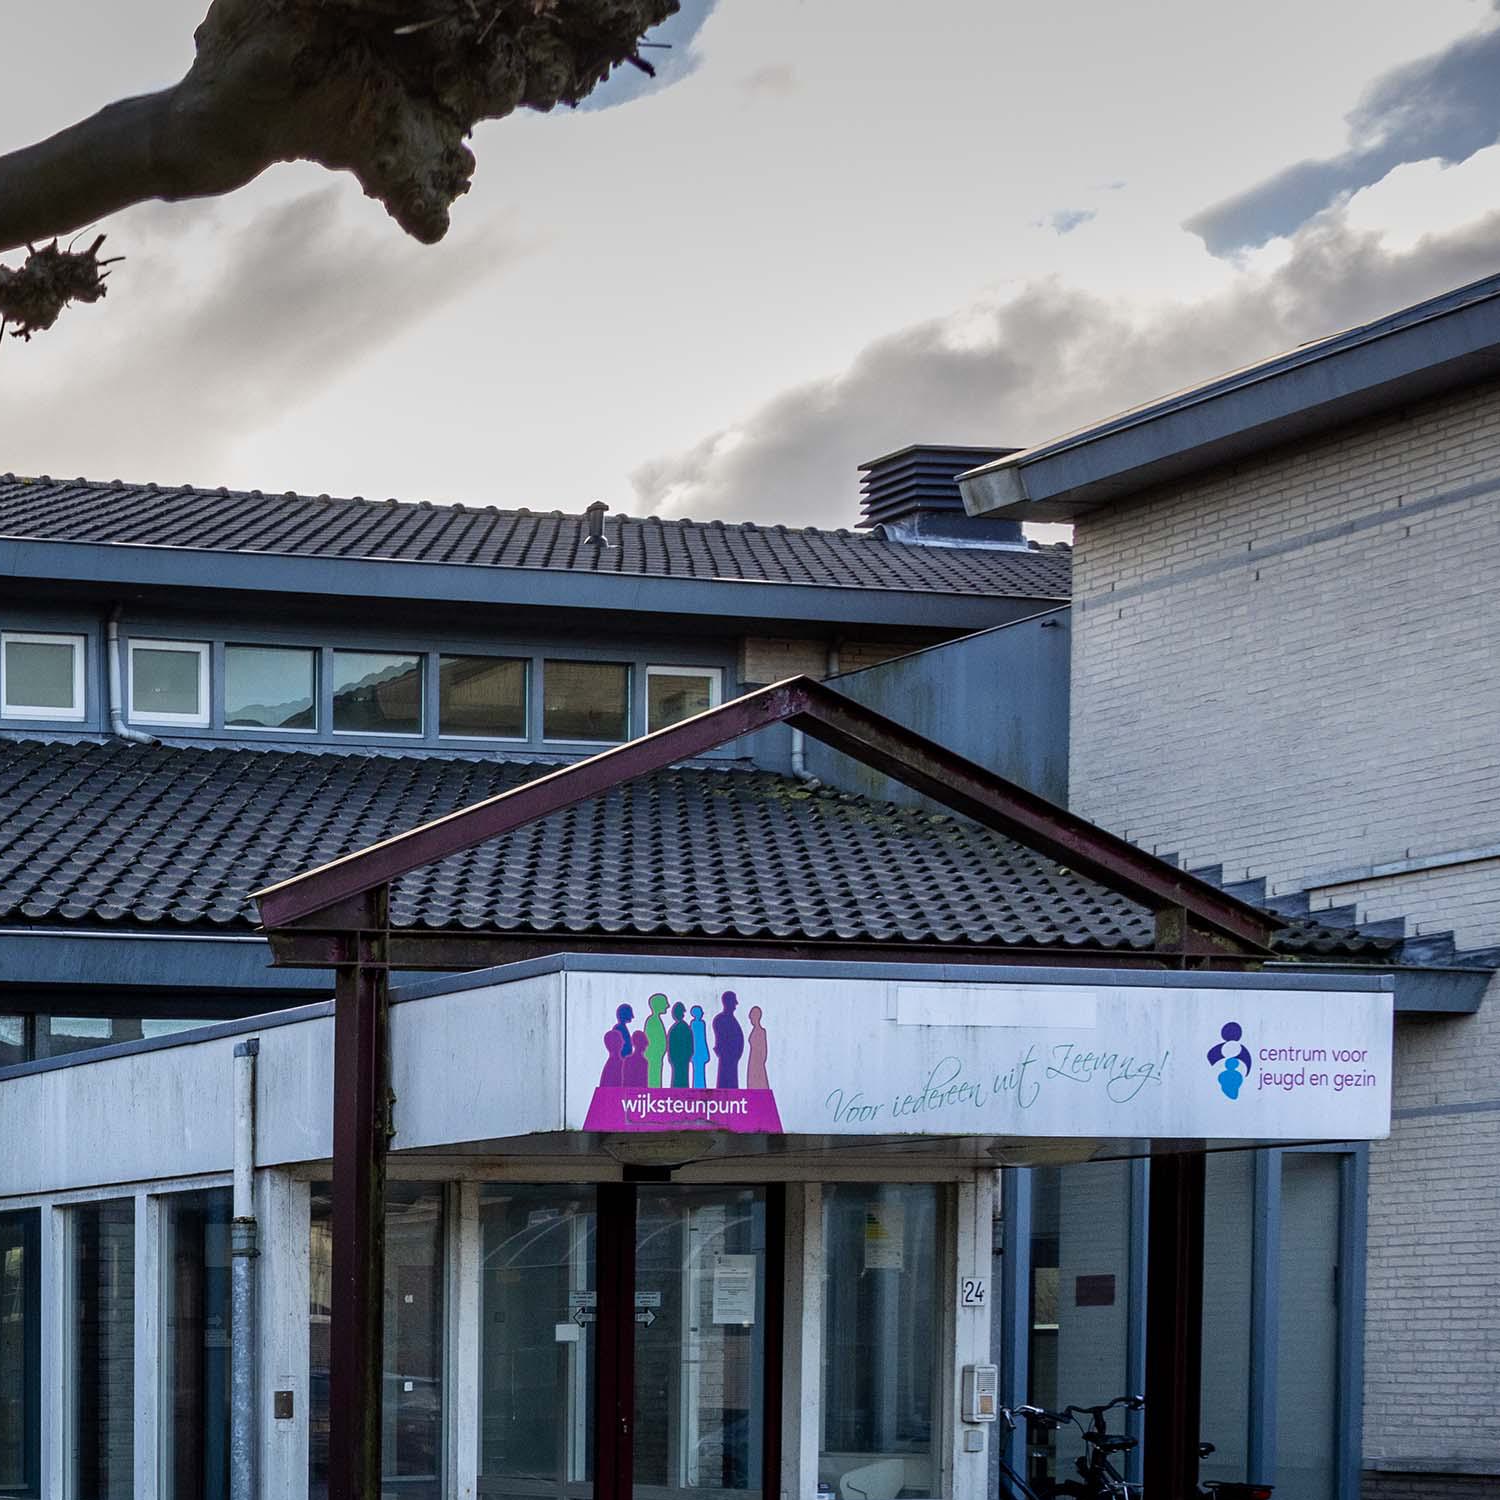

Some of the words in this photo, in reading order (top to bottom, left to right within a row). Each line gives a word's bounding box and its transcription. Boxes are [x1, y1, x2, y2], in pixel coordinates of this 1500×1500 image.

[1259, 1046, 1327, 1062] centrum
[1332, 1049, 1368, 1063] voor
[825, 1088, 885, 1123] Voor
[892, 1056, 987, 1118] iedereen
[993, 1044, 1040, 1108] uit
[1046, 1043, 1170, 1104] Zeevang!
[1258, 1067, 1305, 1091] jeugd
[1309, 1073, 1329, 1087] en
[1333, 1069, 1376, 1092] gezin
[621, 1093, 748, 1119] wijksteunpunt
[965, 1280, 984, 1303] 24
